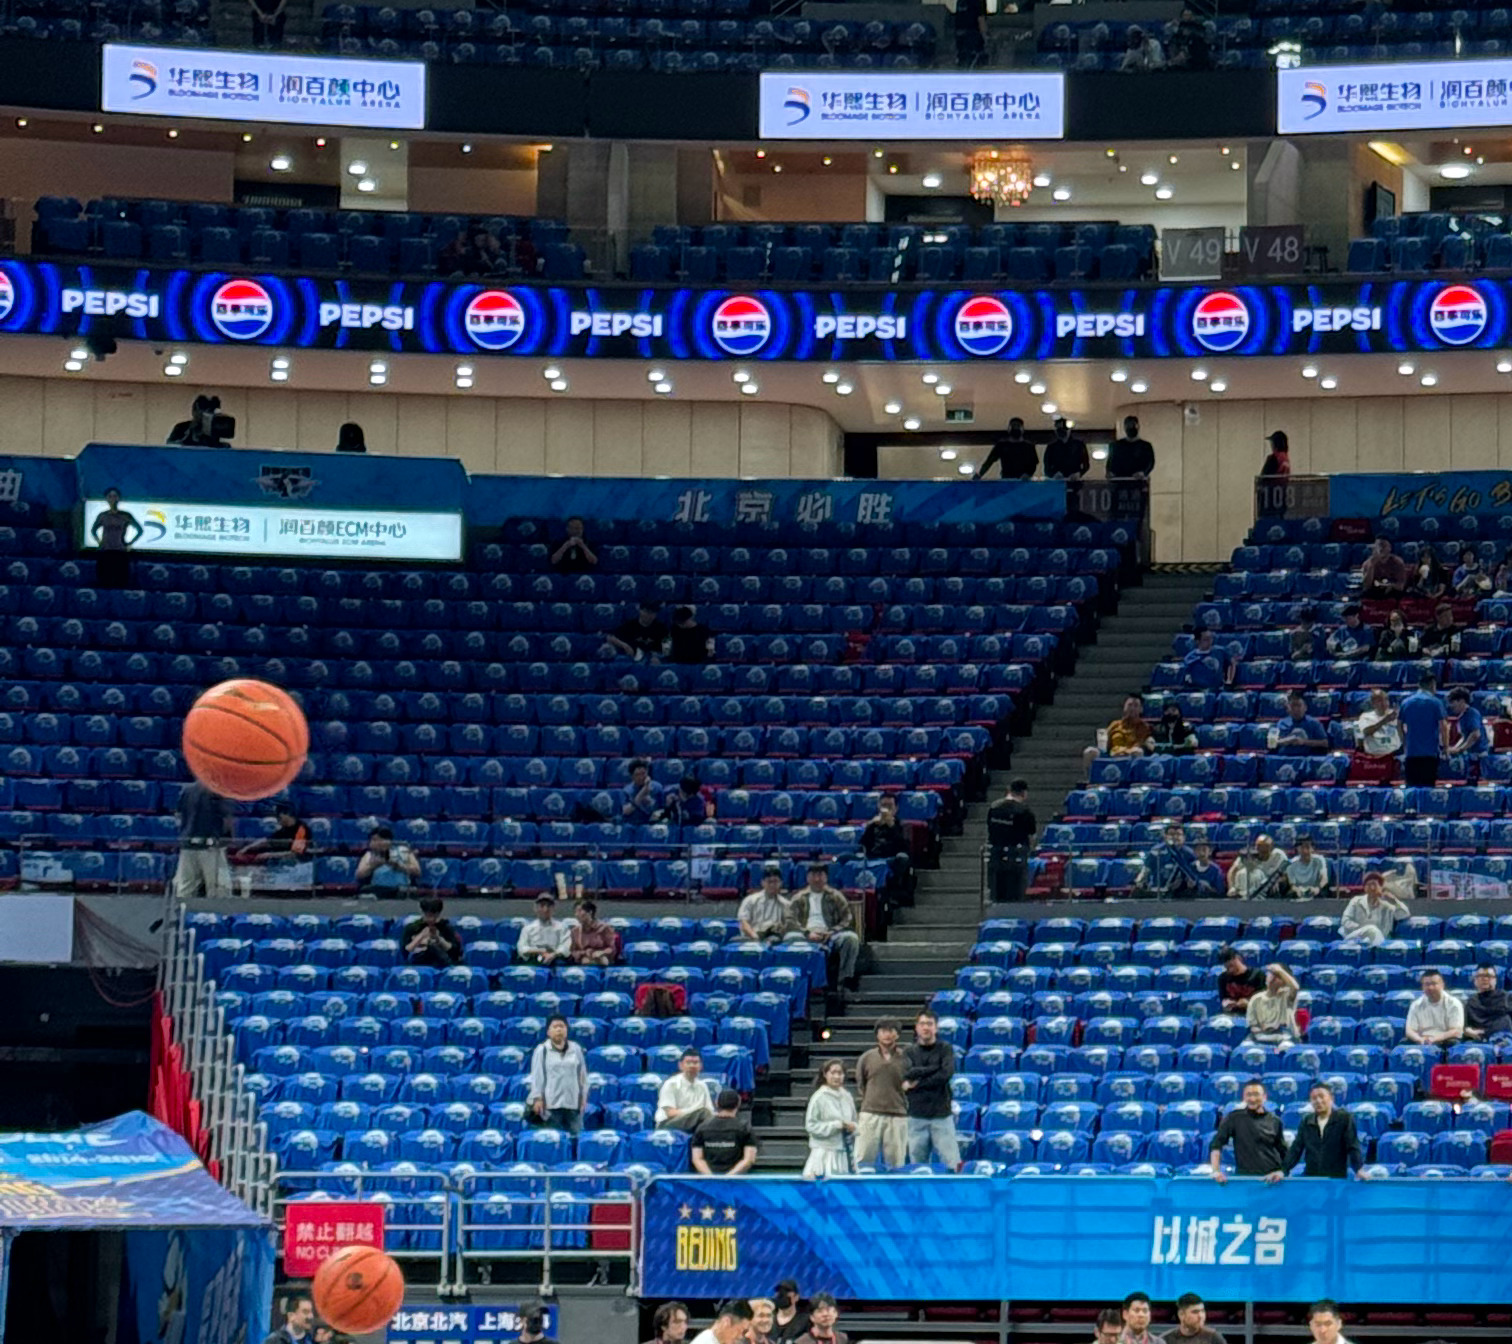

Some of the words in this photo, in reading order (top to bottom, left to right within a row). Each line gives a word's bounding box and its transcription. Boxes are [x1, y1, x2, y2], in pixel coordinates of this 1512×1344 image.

[169, 67, 259, 92] 华熙生物
[280, 74, 400, 102] 润百颜中心
[1337, 81, 1421, 102] 华熙生物
[821, 92, 906, 111] 华熙生物
[926, 92, 1040, 112] 润百颜中心
[1168, 241, 1183, 264] V
[1189, 238, 1221, 264] 49
[1244, 238, 1259, 263] V
[1268, 236, 1300, 263] 48
[63, 290, 158, 316] PEPSI
[321, 304, 413, 329] PEPSI
[572, 312, 661, 336] PEPSI
[816, 316, 905, 338] PEPSI
[1058, 315, 1144, 336] PEPSI
[1294, 308, 1380, 331] PEPSI
[296, 1222, 374, 1242] 禁止翻越
[1151, 1214, 1287, 1266] 以城之名
[676, 1225, 737, 1272] BEIJING
[391, 1312, 468, 1332] 北京北汽
